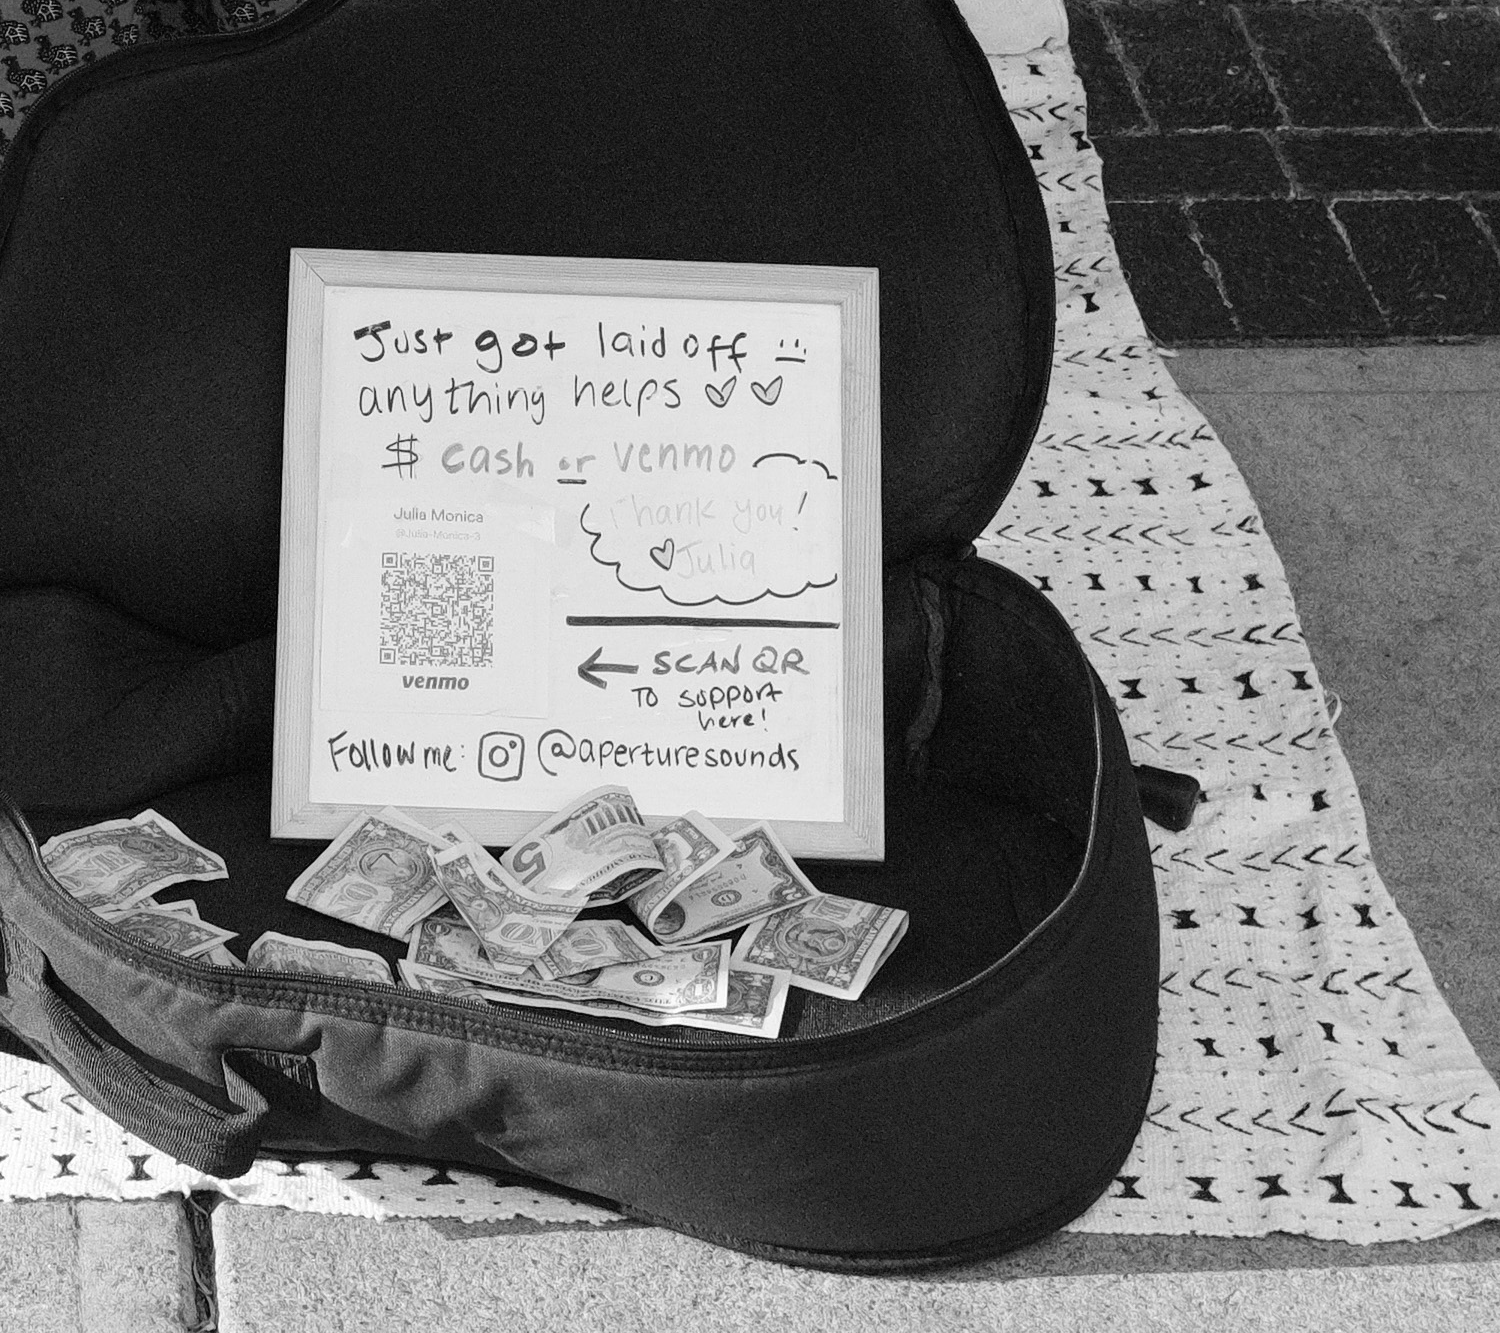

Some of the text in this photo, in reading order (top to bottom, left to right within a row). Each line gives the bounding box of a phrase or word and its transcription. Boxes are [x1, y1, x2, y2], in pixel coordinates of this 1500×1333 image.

[354, 321, 748, 373] Just got laid off
[359, 375, 682, 424] anything helps
[441, 441, 535, 477] cash
[558, 454, 597, 473] or
[614, 441, 737, 474] venmo
[393, 507, 484, 524] Julia Monica
[610, 494, 715, 530] Thank
[676, 540, 757, 580] Julia
[652, 649, 810, 676] SCAN QR
[402, 674, 470, 691] venmo
[679, 683, 783, 711] support
[698, 708, 769, 732] here!
[327, 730, 416, 774] Follow
[512, 841, 547, 887] 5
